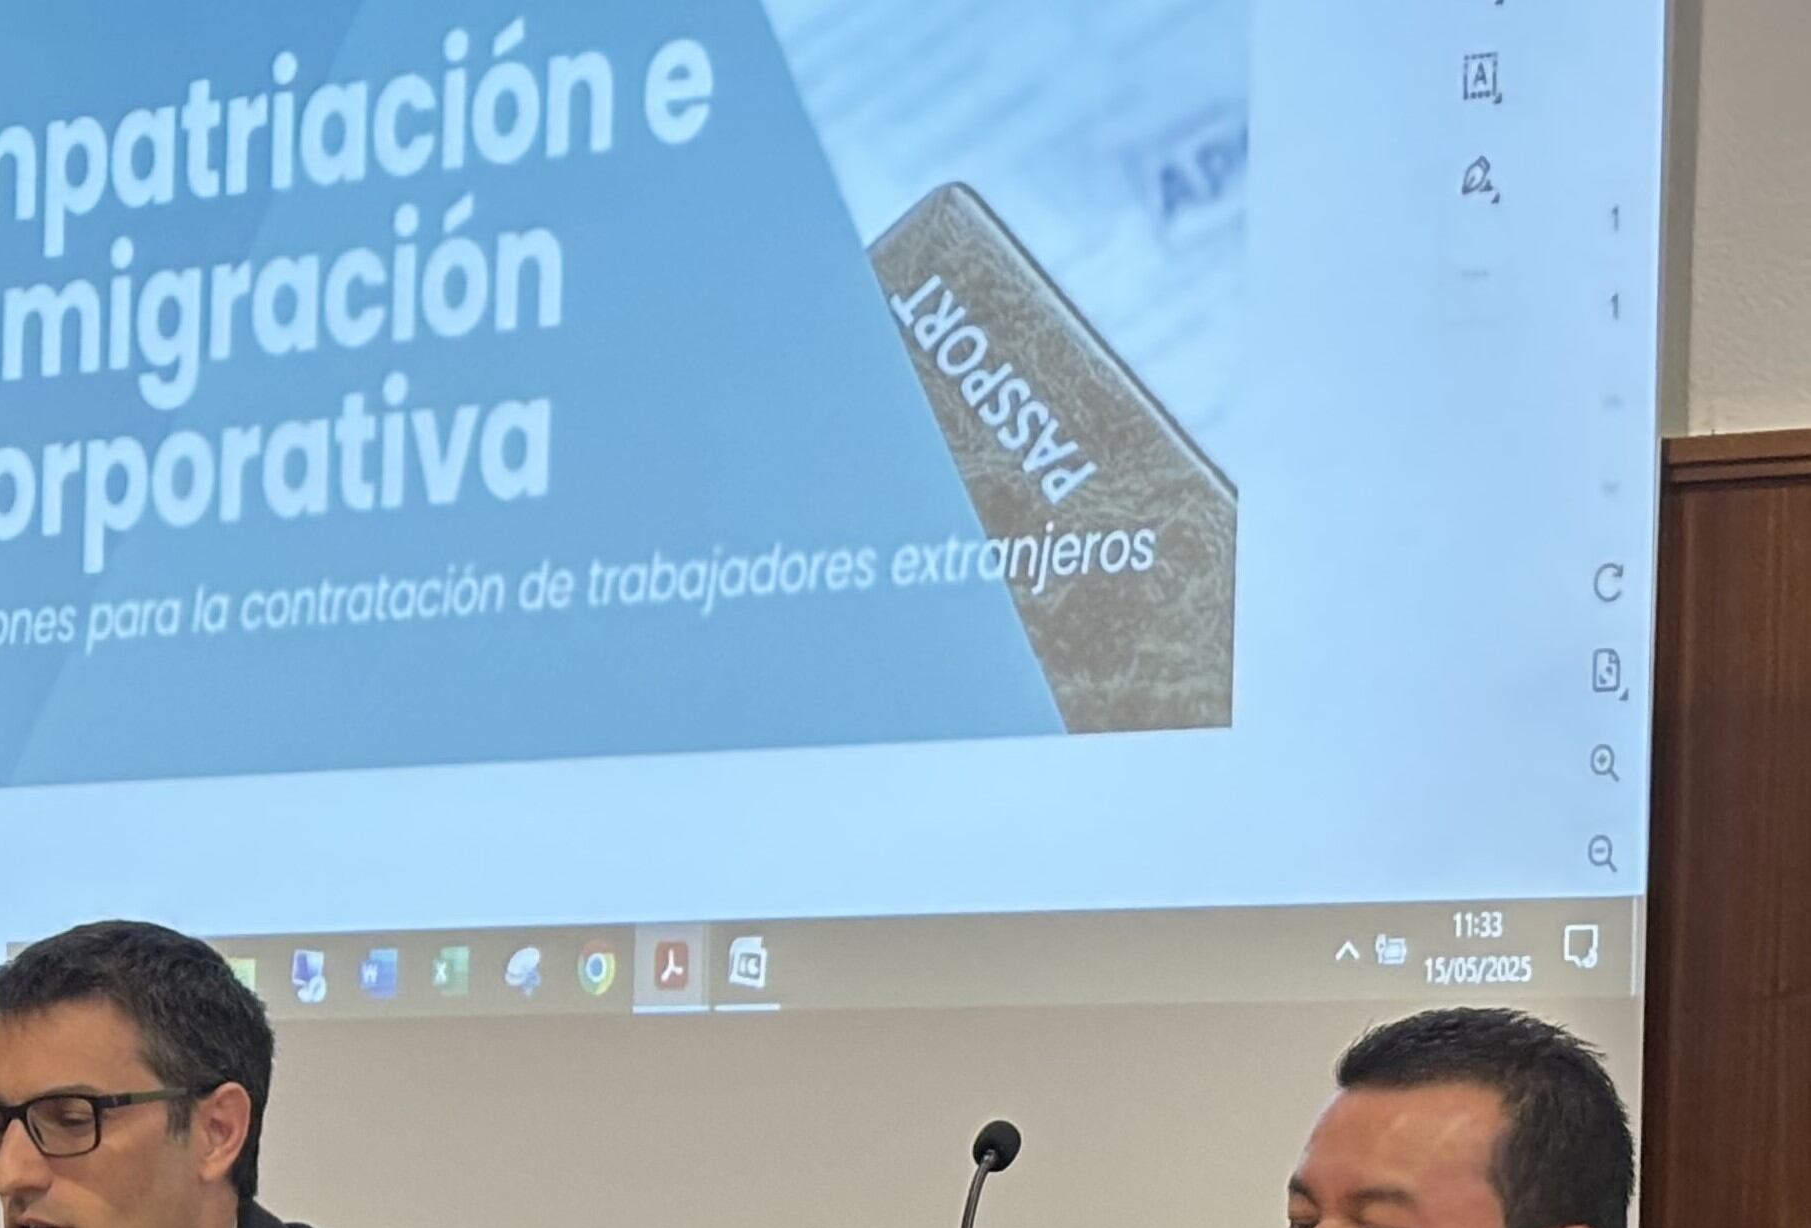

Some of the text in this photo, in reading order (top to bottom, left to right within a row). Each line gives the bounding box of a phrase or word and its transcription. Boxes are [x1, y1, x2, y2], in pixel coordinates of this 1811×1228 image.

[644, 37, 713, 144] e
[889, 273, 1097, 503] PASSPORT
[86, 593, 182, 655] para
[191, 584, 227, 634] la
[240, 563, 506, 630] contratación
[518, 559, 573, 612] de
[588, 539, 875, 617] trabajadores
[891, 525, 1157, 598] extranjeros
[1424, 956, 1532, 985] 15/05/2025
[1453, 911, 1503, 938] 11:33
